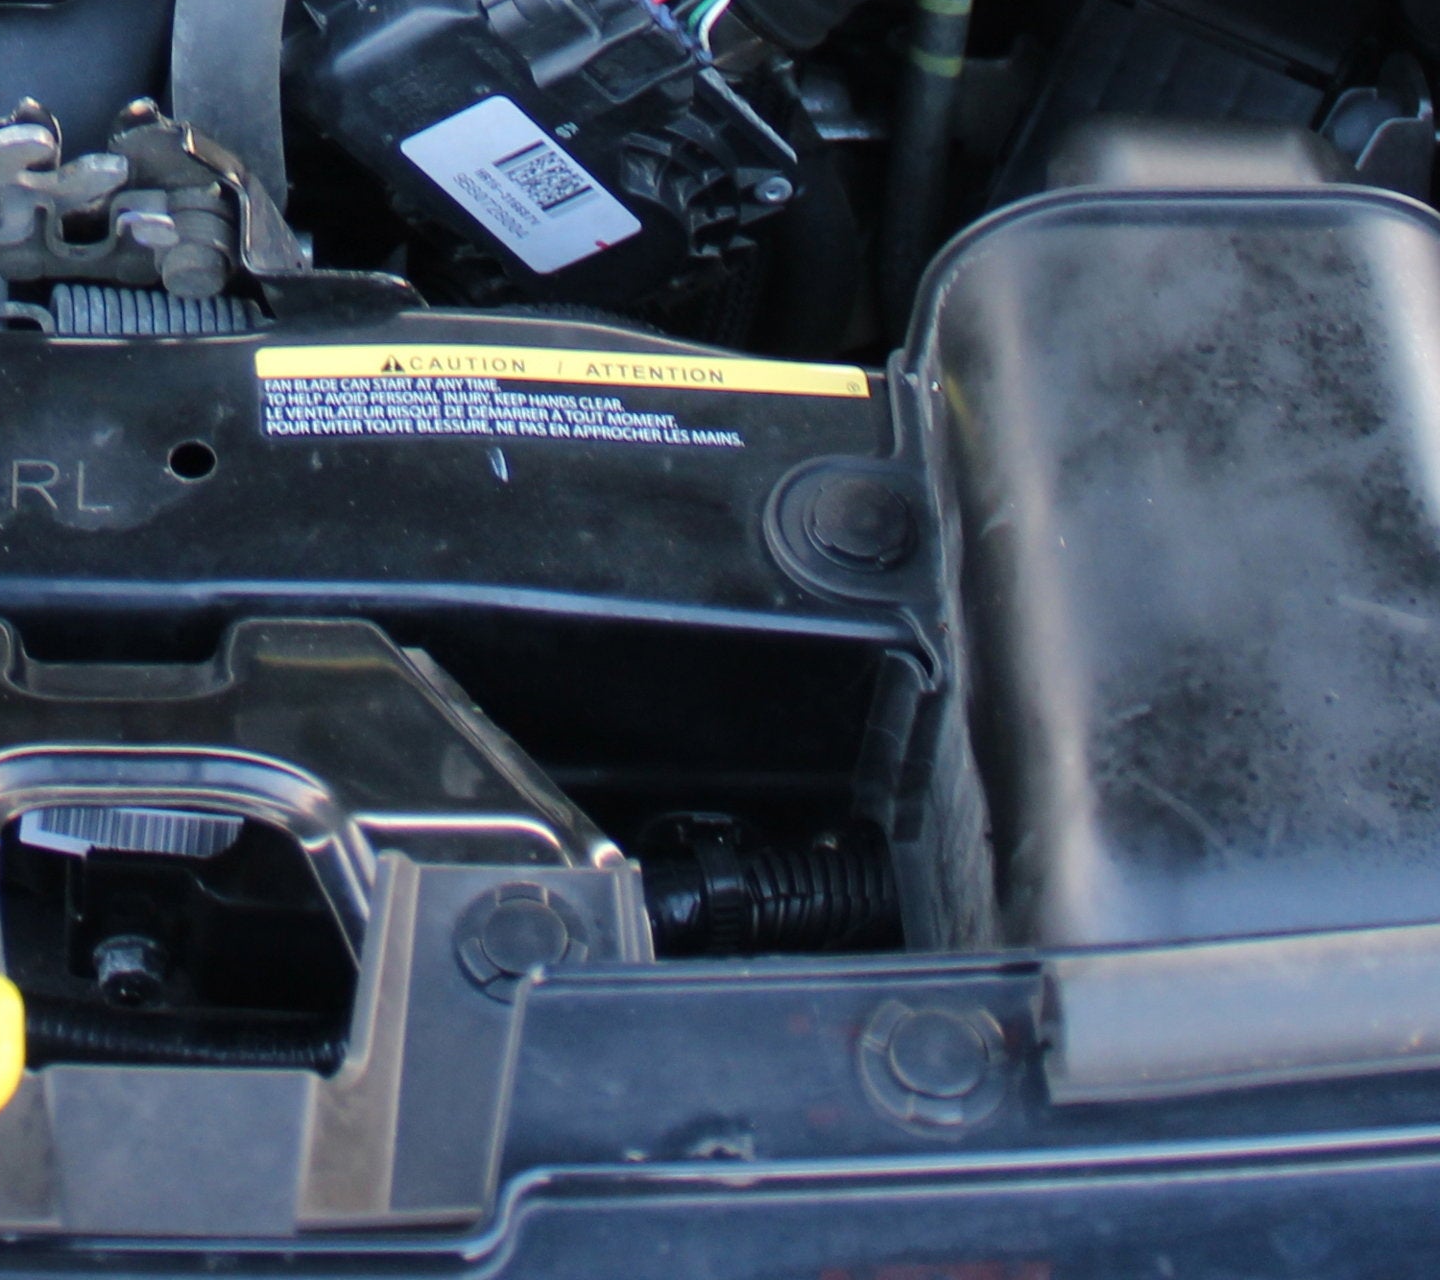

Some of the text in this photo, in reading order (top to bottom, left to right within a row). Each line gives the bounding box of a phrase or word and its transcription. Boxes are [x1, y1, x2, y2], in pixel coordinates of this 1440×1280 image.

[409, 355, 527, 374] CAUTION
[584, 361, 725, 384] ATTENTION
[265, 378, 292, 392] FAN
[294, 378, 338, 392] BLADE
[341, 378, 371, 392] CAN
[373, 378, 412, 392] START
[415, 378, 433, 392] AT
[436, 378, 464, 392] ANY
[266, 392, 286, 407] TO
[288, 392, 324, 407] HELP
[325, 392, 368, 406] AVOID
[370, 392, 441, 407] PERSONAL
[493, 393, 527, 407] KEEP
[529, 394, 577, 410] HANDS
[266, 406, 283, 420] LE
[285, 405, 385, 420] VENTILATEUR
[387, 405, 442, 419] RISQUE
[445, 405, 465, 419] DE
[566, 410, 605, 426] TOUT
[267, 421, 310, 435] POUR
[364, 420, 415, 434] TOUTE
[496, 420, 517, 435] NE
[519, 421, 547, 437] PAS
[549, 422, 571, 438] EN
[572, 424, 661, 442] APPROCHER
[664, 428, 690, 444] LES
